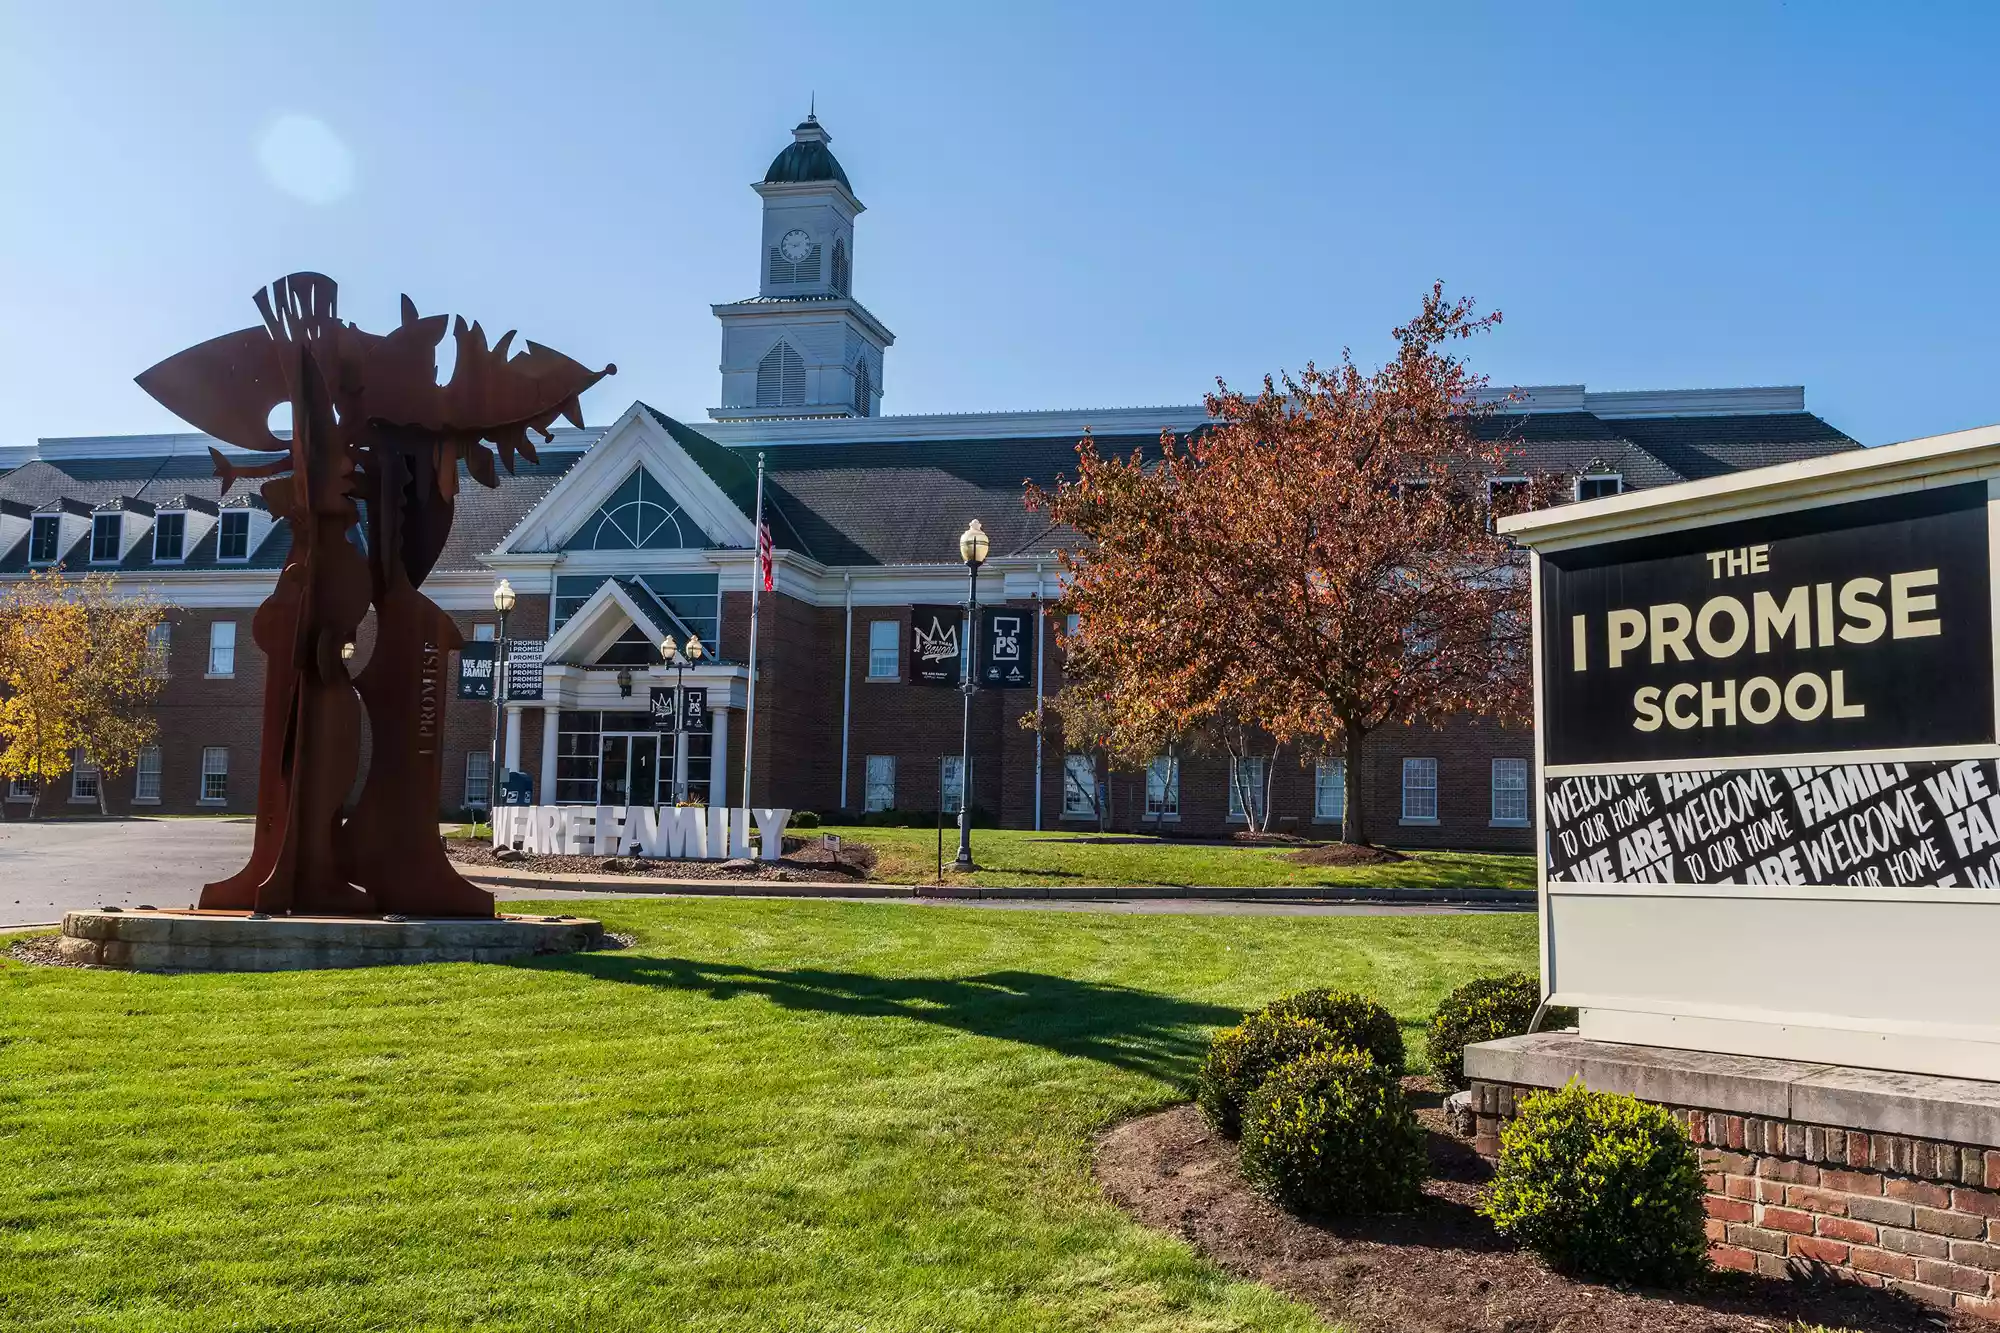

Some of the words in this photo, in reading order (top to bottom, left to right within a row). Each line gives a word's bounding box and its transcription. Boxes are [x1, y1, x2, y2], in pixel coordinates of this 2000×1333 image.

[1706, 543, 1770, 579] THE
[1572, 614, 1588, 672] I
[1608, 568, 1942, 669] PROMISE
[462, 659, 476, 668] WE
[476, 659, 492, 669] ARE
[462, 668, 492, 677] FAMILY
[1632, 669, 1866, 732] SCHOOL
[640, 755, 646, 767] 1
[1922, 759, 1991, 817] WE
[493, 806, 529, 850] WE
[523, 806, 594, 855] ARE
[594, 806, 792, 861] FAMILY
[1559, 829, 1578, 858] TO
[1579, 813, 1610, 848] OUR
[1609, 787, 1655, 833] HOME
[1666, 768, 1784, 852] WELCOME
[1800, 785, 1934, 882] WELCOME
[1618, 818, 1672, 877] ARE
[1684, 852, 1706, 882] TO
[1707, 836, 1742, 873] OUR
[1741, 809, 1794, 857] HOME
[1885, 837, 1946, 887] HOME
